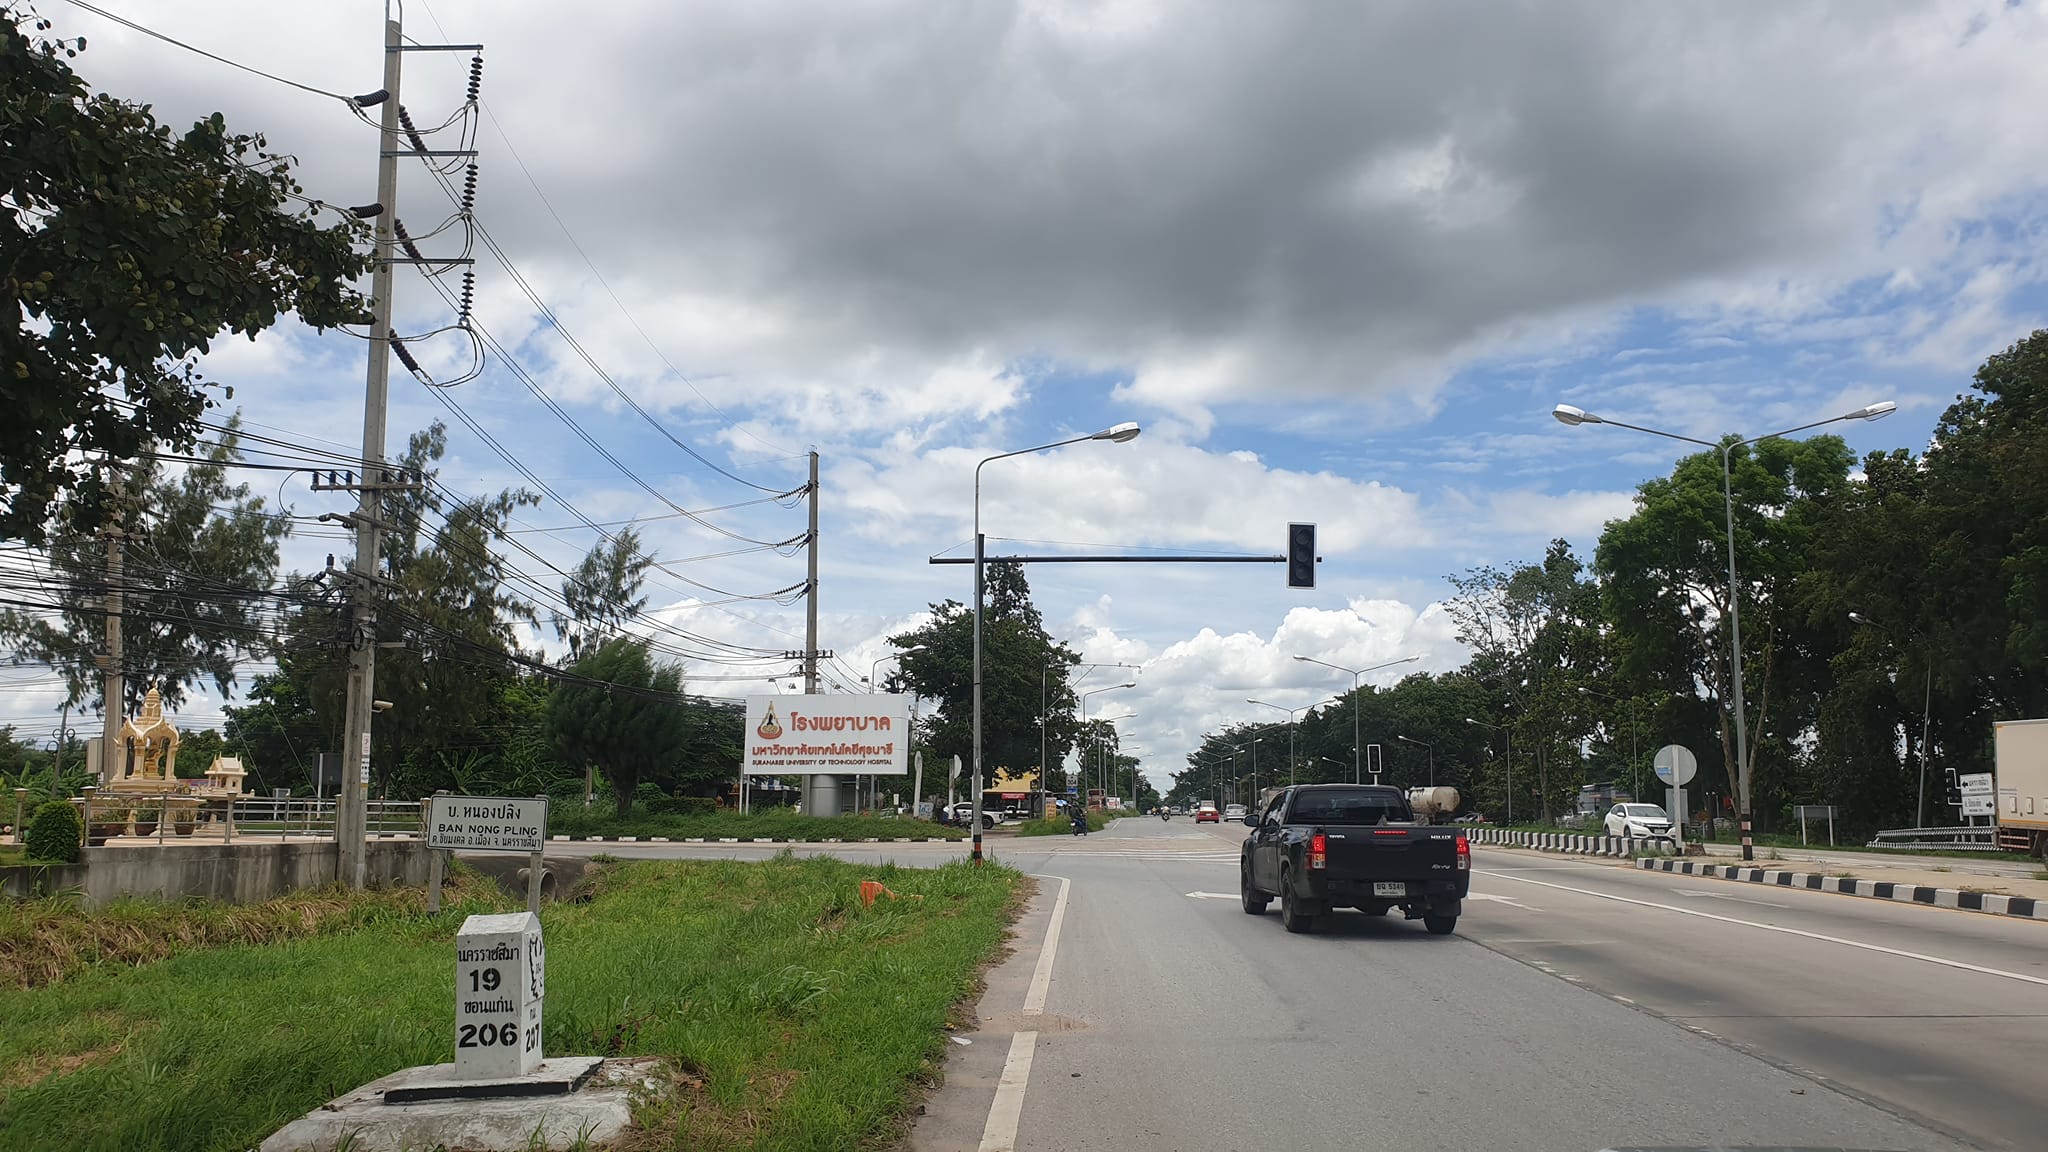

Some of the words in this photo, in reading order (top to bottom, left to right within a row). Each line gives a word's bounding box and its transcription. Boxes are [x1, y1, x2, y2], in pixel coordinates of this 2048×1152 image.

[790, 711, 891, 731] โรงพยาบาล
[448, 806, 459, 818] บ.
[463, 804, 521, 819] หนองปลิง
[439, 824, 463, 833] BAN
[468, 825, 500, 834] NONG
[503, 826, 538, 836] PLING
[458, 942, 520, 962] นครราชสีมา
[469, 968, 501, 992] 19
[464, 996, 514, 1014] ขอนแก่น
[459, 1022, 518, 1048] 206
[525, 1023, 540, 1053] 207
